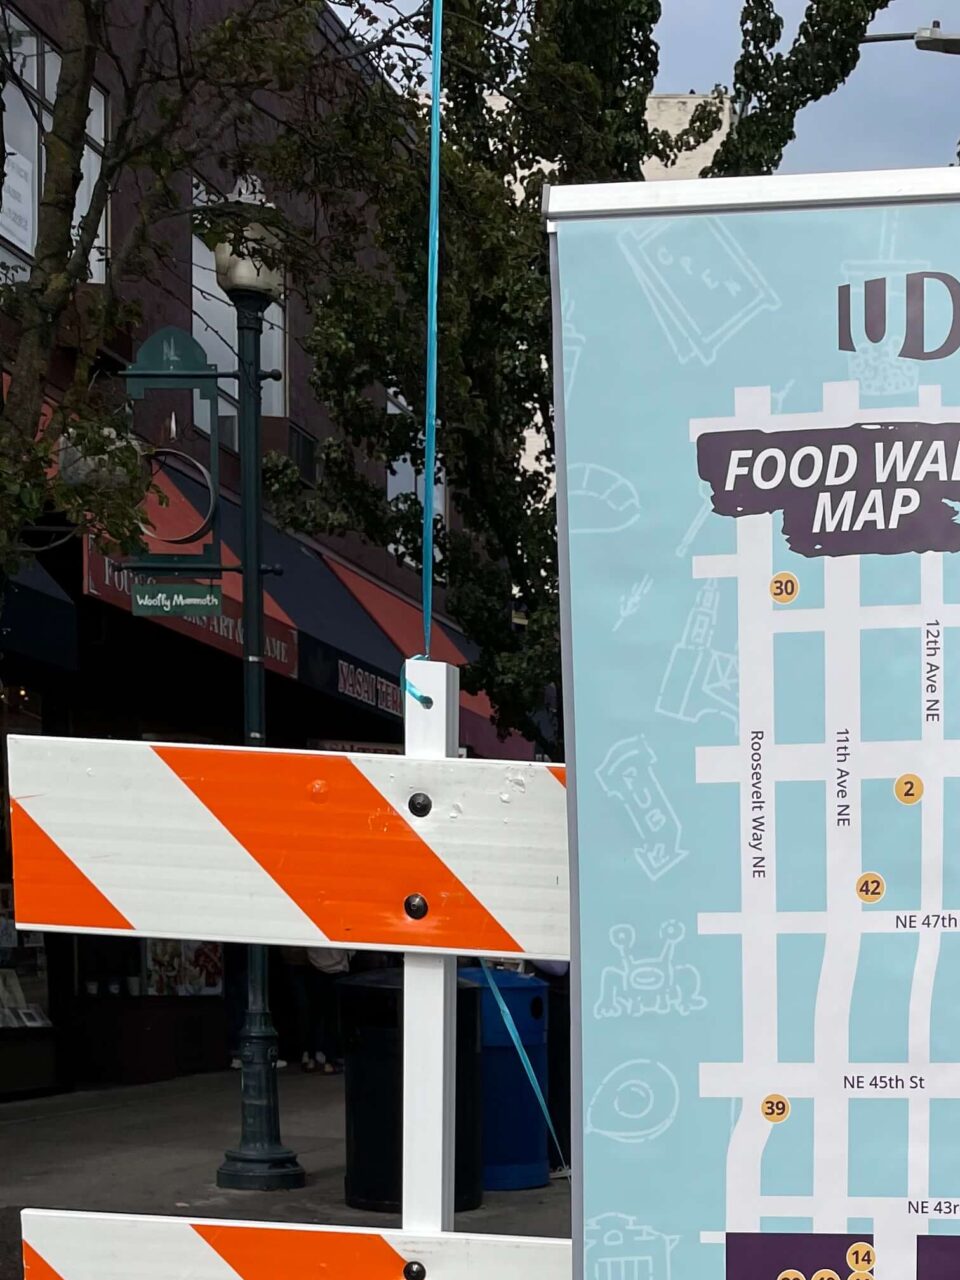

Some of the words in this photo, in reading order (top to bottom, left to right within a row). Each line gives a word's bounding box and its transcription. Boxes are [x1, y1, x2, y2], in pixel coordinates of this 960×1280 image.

[723, 443, 858, 491] FOOD
[812, 487, 921, 534] MAP
[773, 579, 795, 596] 30
[926, 619, 941, 657] 12th
[925, 662, 940, 694] Ave
[926, 699, 940, 722] NE
[836, 728, 851, 763] 11th
[751, 730, 766, 811] Roosevelt
[836, 768, 850, 799] Ave
[903, 780, 915, 797] 2
[837, 804, 851, 827] NE
[748, 815, 765, 851] Way
[752, 856, 766, 878] NE
[859, 879, 881, 896] 42
[895, 914, 917, 929] NE
[921, 913, 958, 928] 47th
[843, 1075, 865, 1089] NE
[869, 1074, 905, 1089] 45th
[909, 1075, 925, 1089] St
[764, 1100, 786, 1116] 39
[908, 1200, 929, 1214] NE
